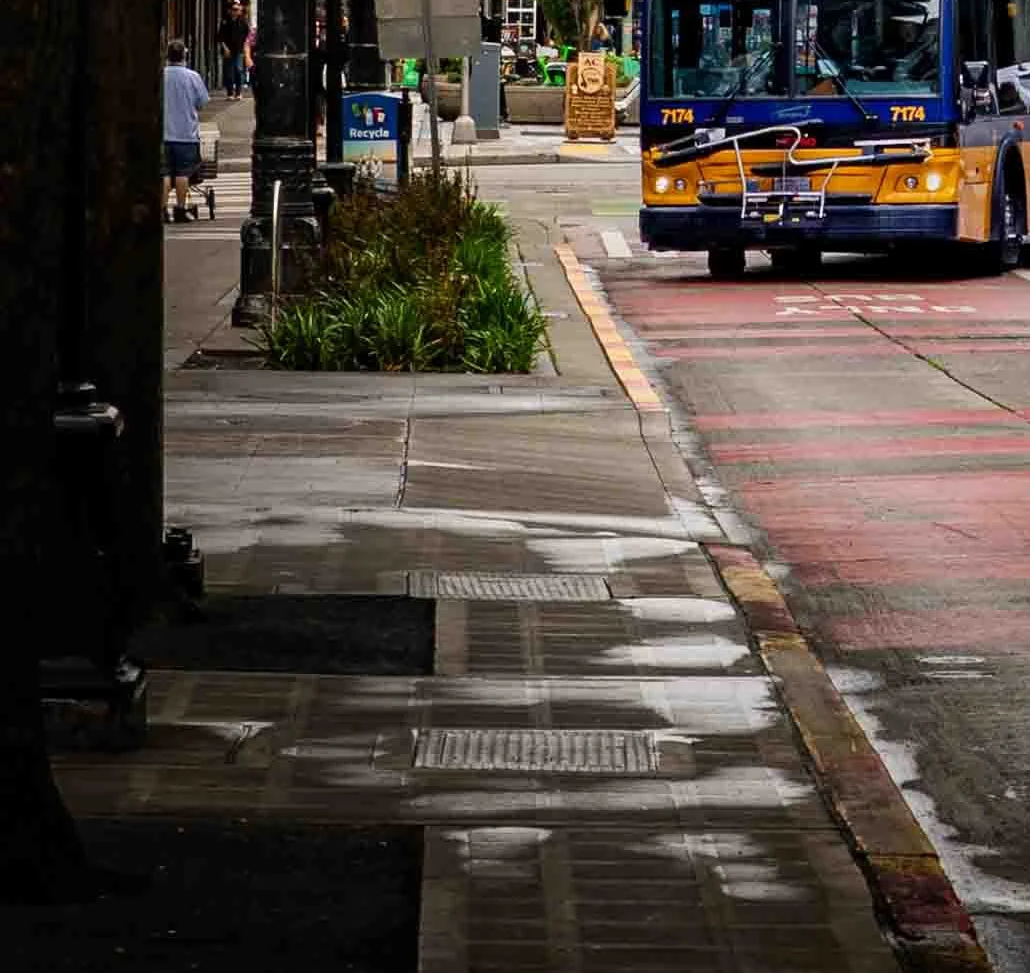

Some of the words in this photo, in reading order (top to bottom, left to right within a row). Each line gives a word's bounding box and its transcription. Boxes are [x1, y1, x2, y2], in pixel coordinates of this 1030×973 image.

[661, 108, 694, 124] 7174
[890, 106, 925, 122] 7174
[349, 127, 390, 139] Recycle
